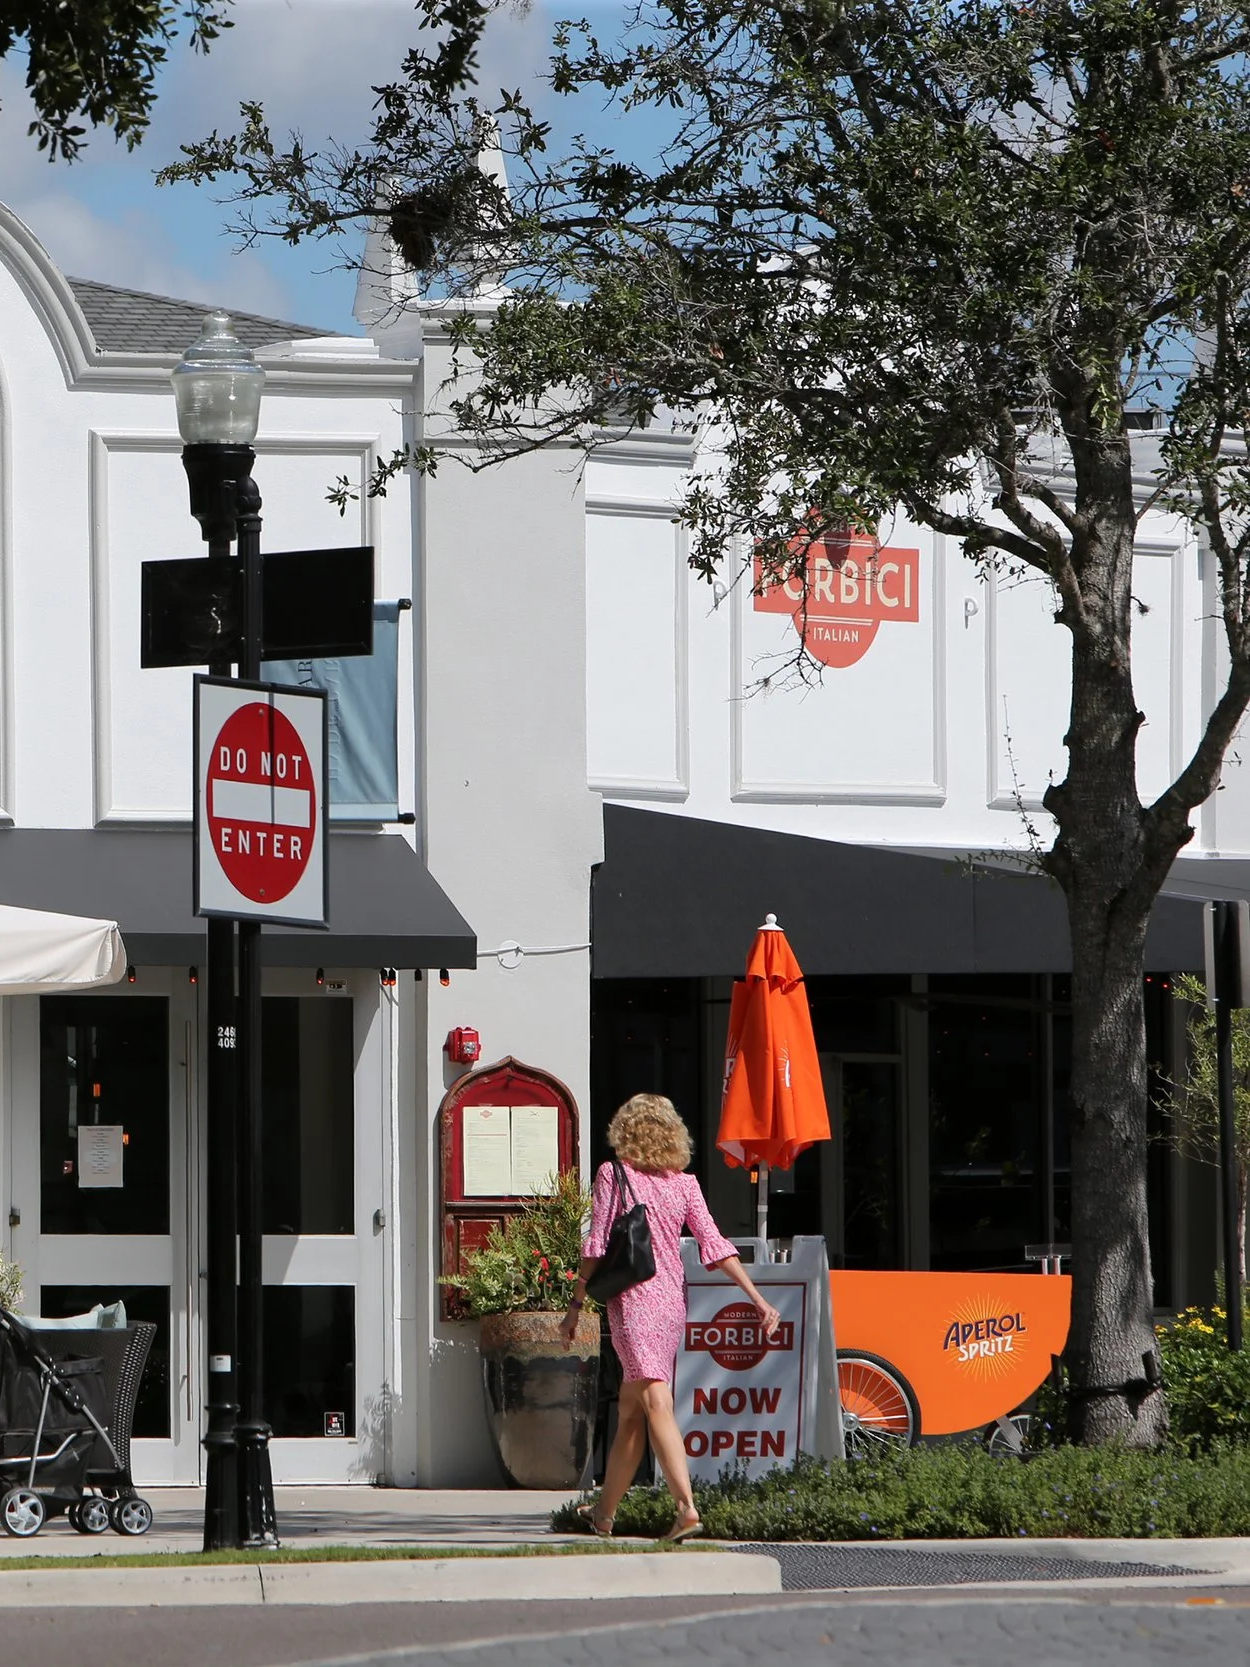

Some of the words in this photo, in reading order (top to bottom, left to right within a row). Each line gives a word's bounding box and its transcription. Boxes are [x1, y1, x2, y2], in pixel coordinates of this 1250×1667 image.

[813, 627, 859, 643] ITALIAN
[220, 746, 247, 774] DO
[260, 751, 302, 780] NOT
[221, 827, 302, 860] ENTER
[690, 1327, 788, 1346] FORBICI
[943, 1313, 1027, 1351] APEROL
[693, 1387, 782, 1415] NOW
[683, 1430, 785, 1458] OPEN
